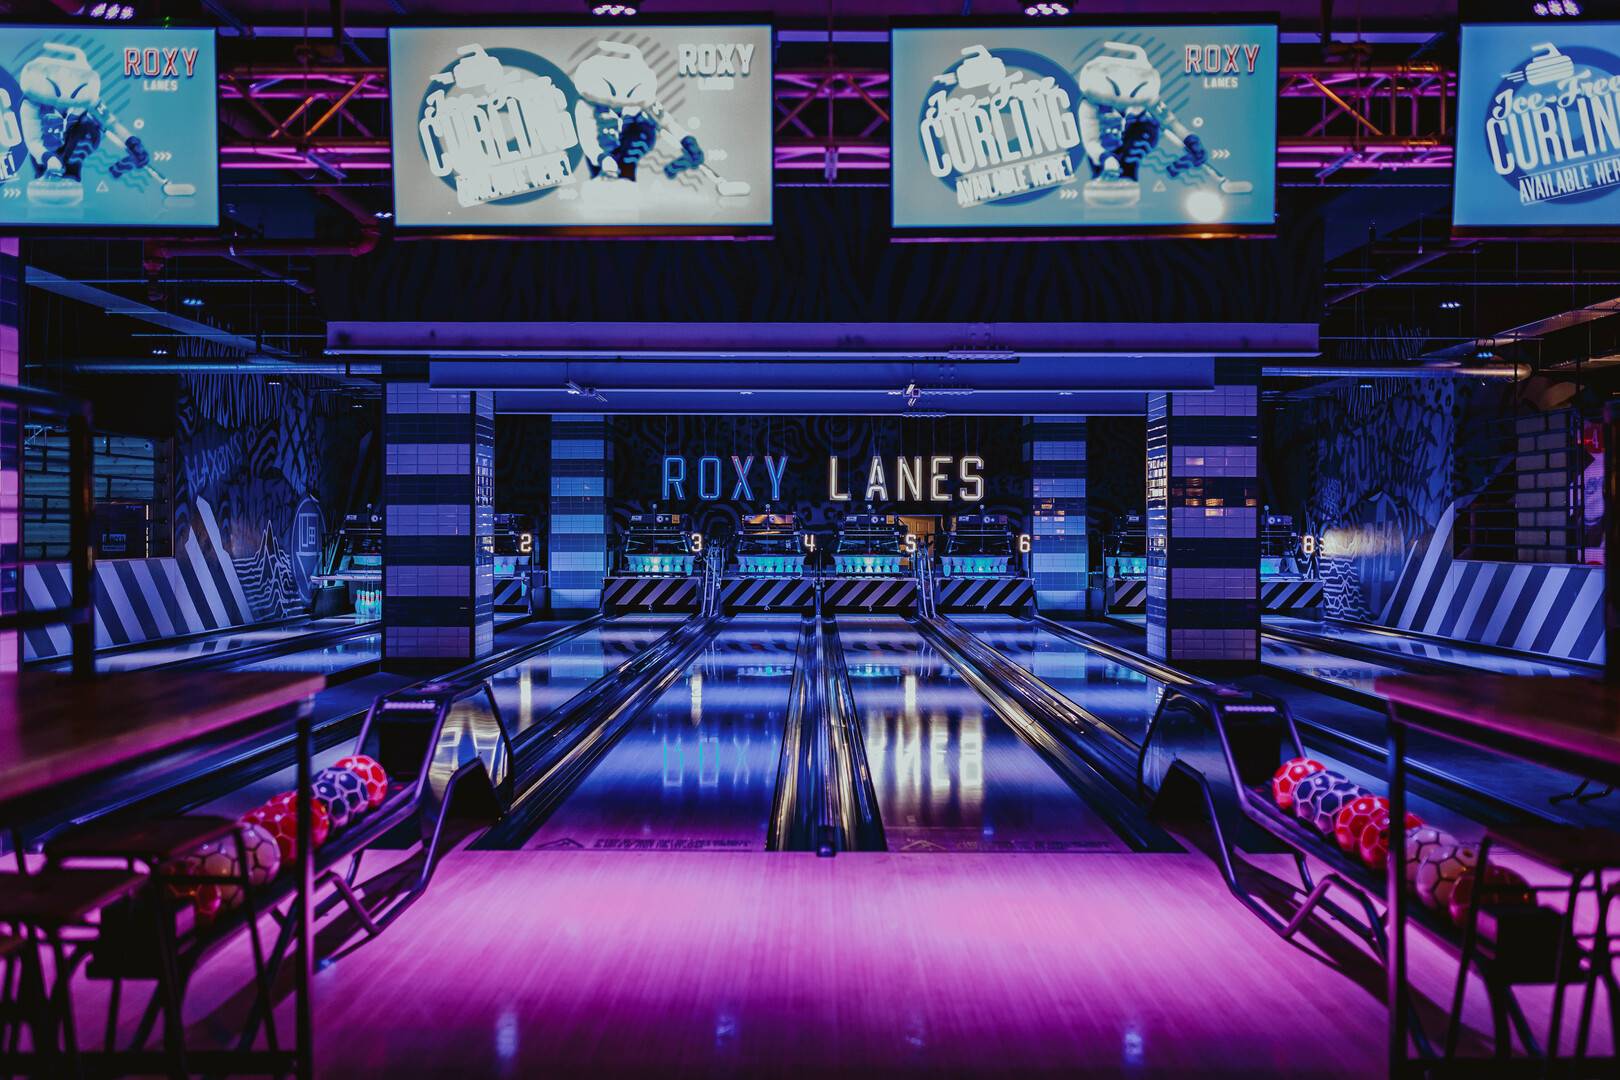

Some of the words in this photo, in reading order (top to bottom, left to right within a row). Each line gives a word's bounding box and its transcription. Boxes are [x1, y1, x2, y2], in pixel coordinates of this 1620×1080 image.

[124, 47, 199, 78] ROXY
[677, 44, 754, 76] ROXY
[1184, 45, 1261, 74] ROXY
[143, 80, 179, 92] LANES
[1203, 77, 1239, 89] LANES
[921, 88, 1080, 177] CURLING
[1486, 92, 1620, 175] CURLIN
[1519, 165, 1592, 203] AVAILABLE
[662, 455, 788, 501] ROXY
[829, 455, 984, 501] LANES
[520, 533, 532, 552] 2
[691, 533, 703, 552] 3
[804, 533, 816, 552] 4
[905, 533, 917, 552] 5
[1019, 533, 1031, 553] 6
[1303, 535, 1315, 553] 8
